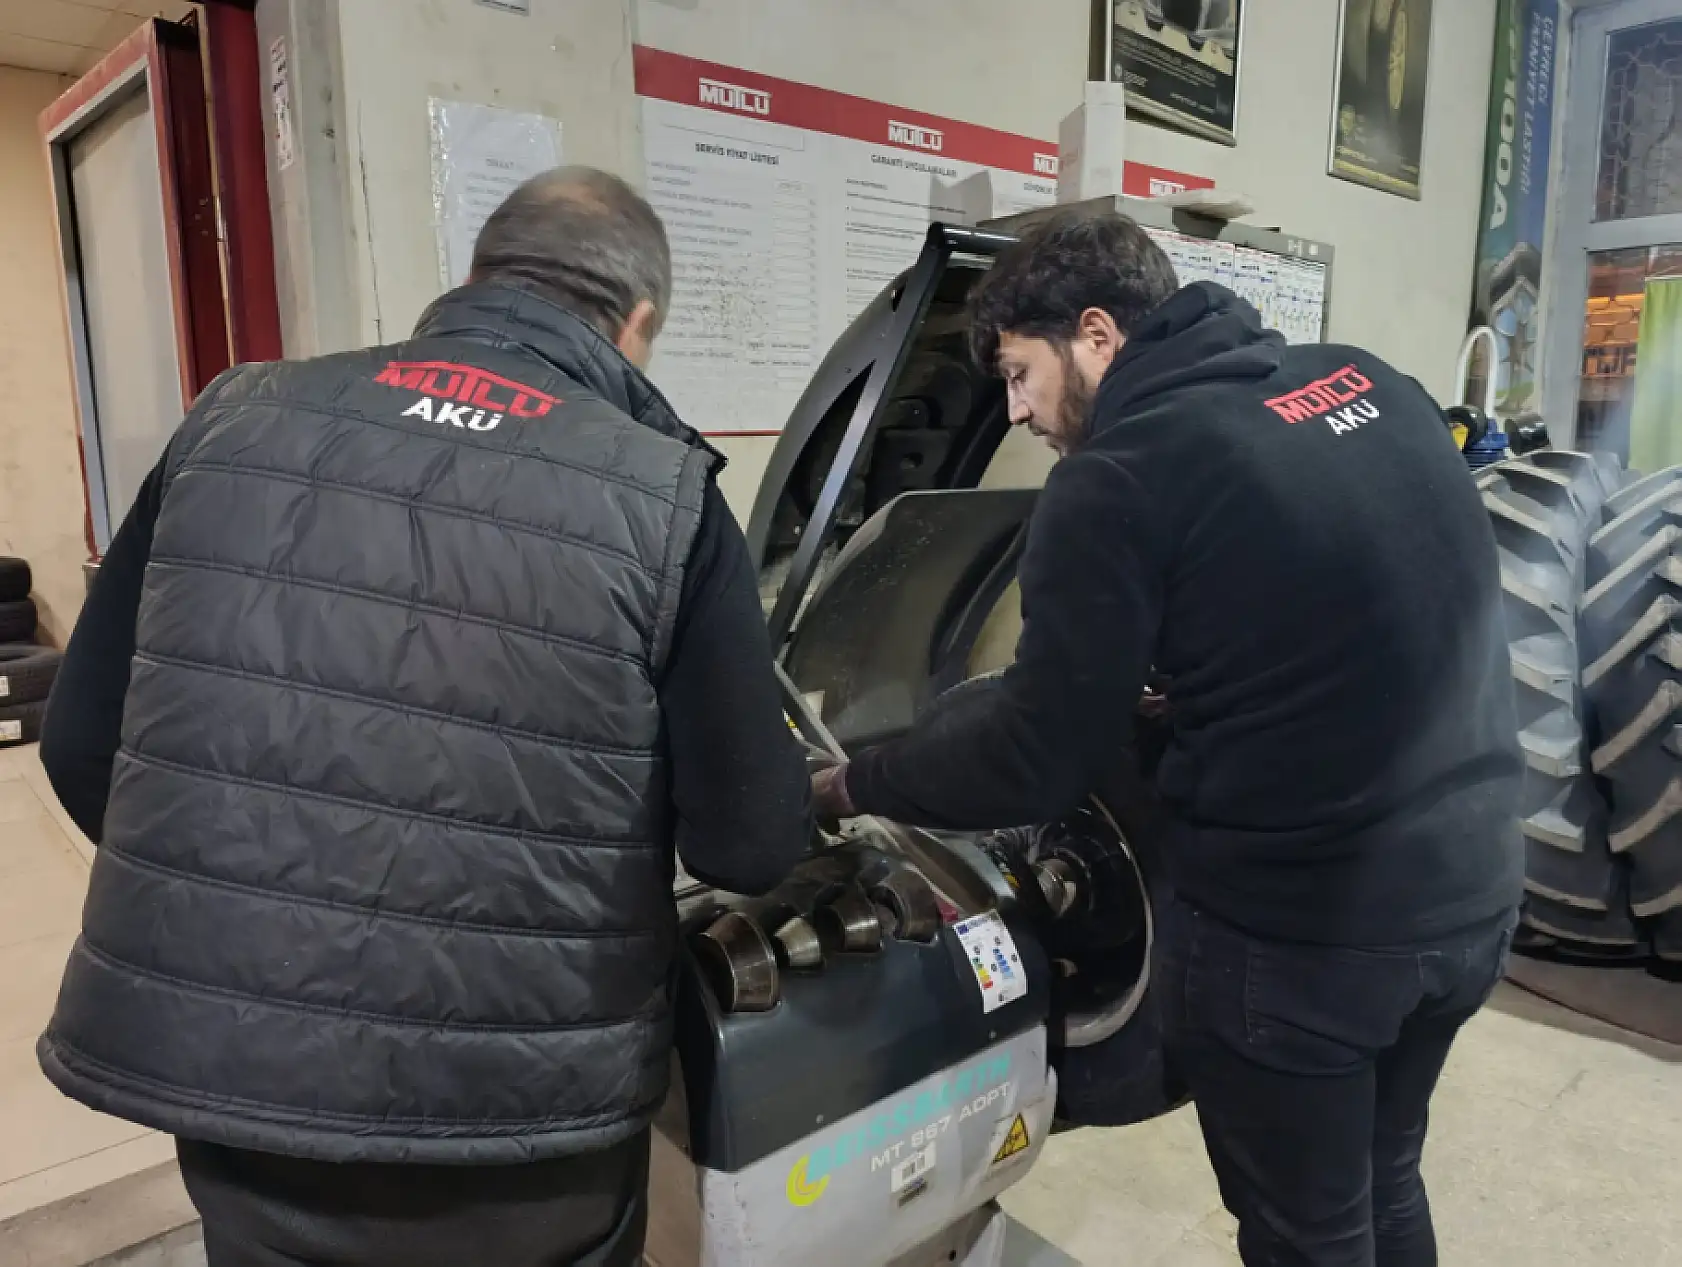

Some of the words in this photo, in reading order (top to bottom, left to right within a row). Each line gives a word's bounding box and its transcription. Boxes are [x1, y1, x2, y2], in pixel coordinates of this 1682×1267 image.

[698, 77, 772, 115] MUTLU
[887, 119, 944, 152] MUTLU
[373, 360, 566, 418] MUTLU
[1263, 363, 1375, 425] MUTLU
[401, 396, 504, 431] AKÜ
[871, 1140, 905, 1172] MT
